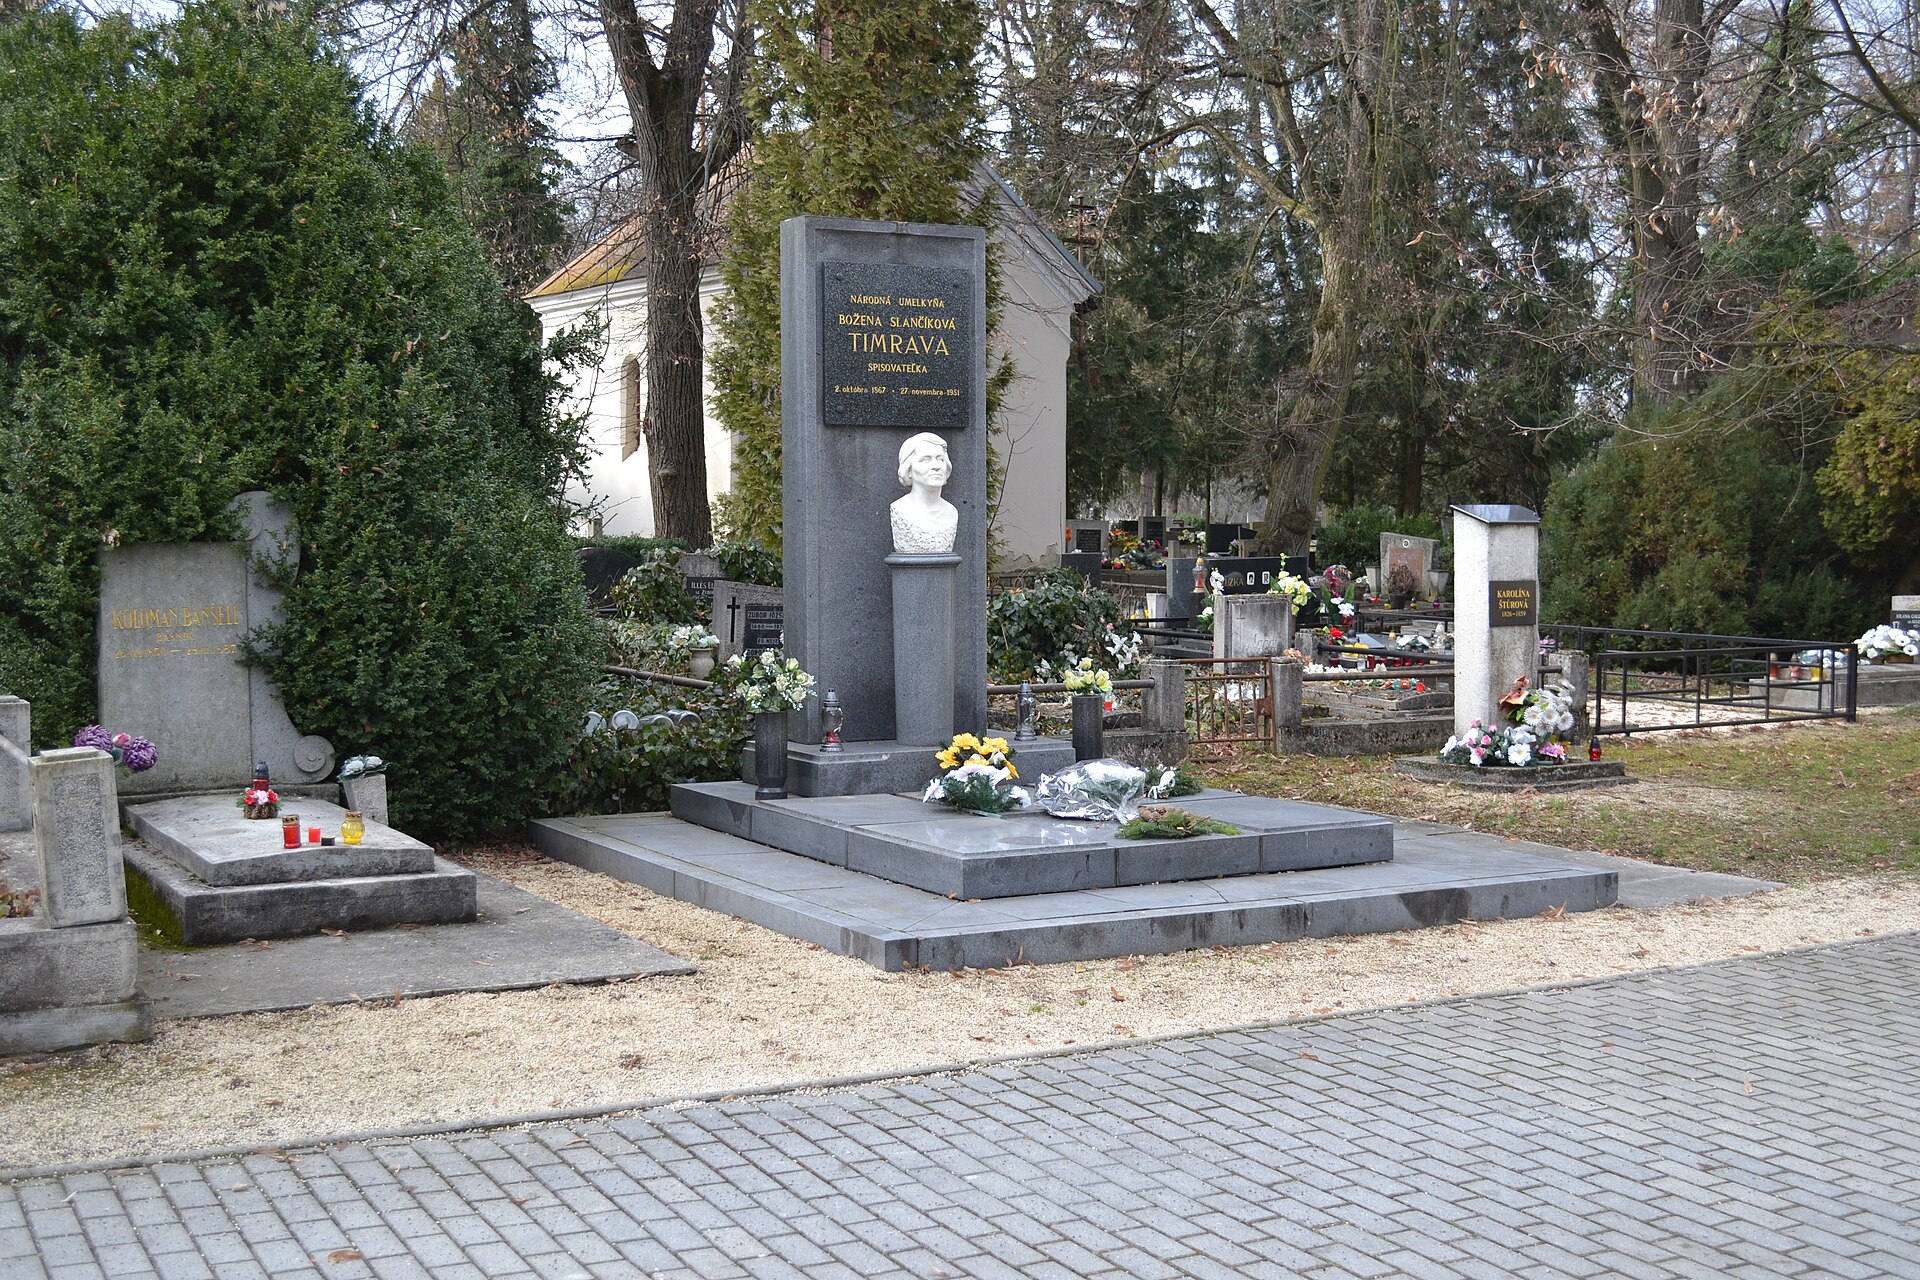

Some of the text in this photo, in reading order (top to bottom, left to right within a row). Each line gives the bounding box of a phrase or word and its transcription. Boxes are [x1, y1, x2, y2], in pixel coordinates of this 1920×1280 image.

[851, 294, 945, 308] NÁRODNÁ UMELKYŇA
[839, 313, 956, 330] BOŽENA SLANČÍKOVÁ
[849, 333, 949, 356] TIMRAVA
[868, 363, 928, 374] SPISOVATEĽKA
[1497, 588, 1530, 598] KAROLÍNA
[1499, 599, 1529, 609] ŠTÚROVÁ
[113, 608, 179, 630] KOLOMAN
